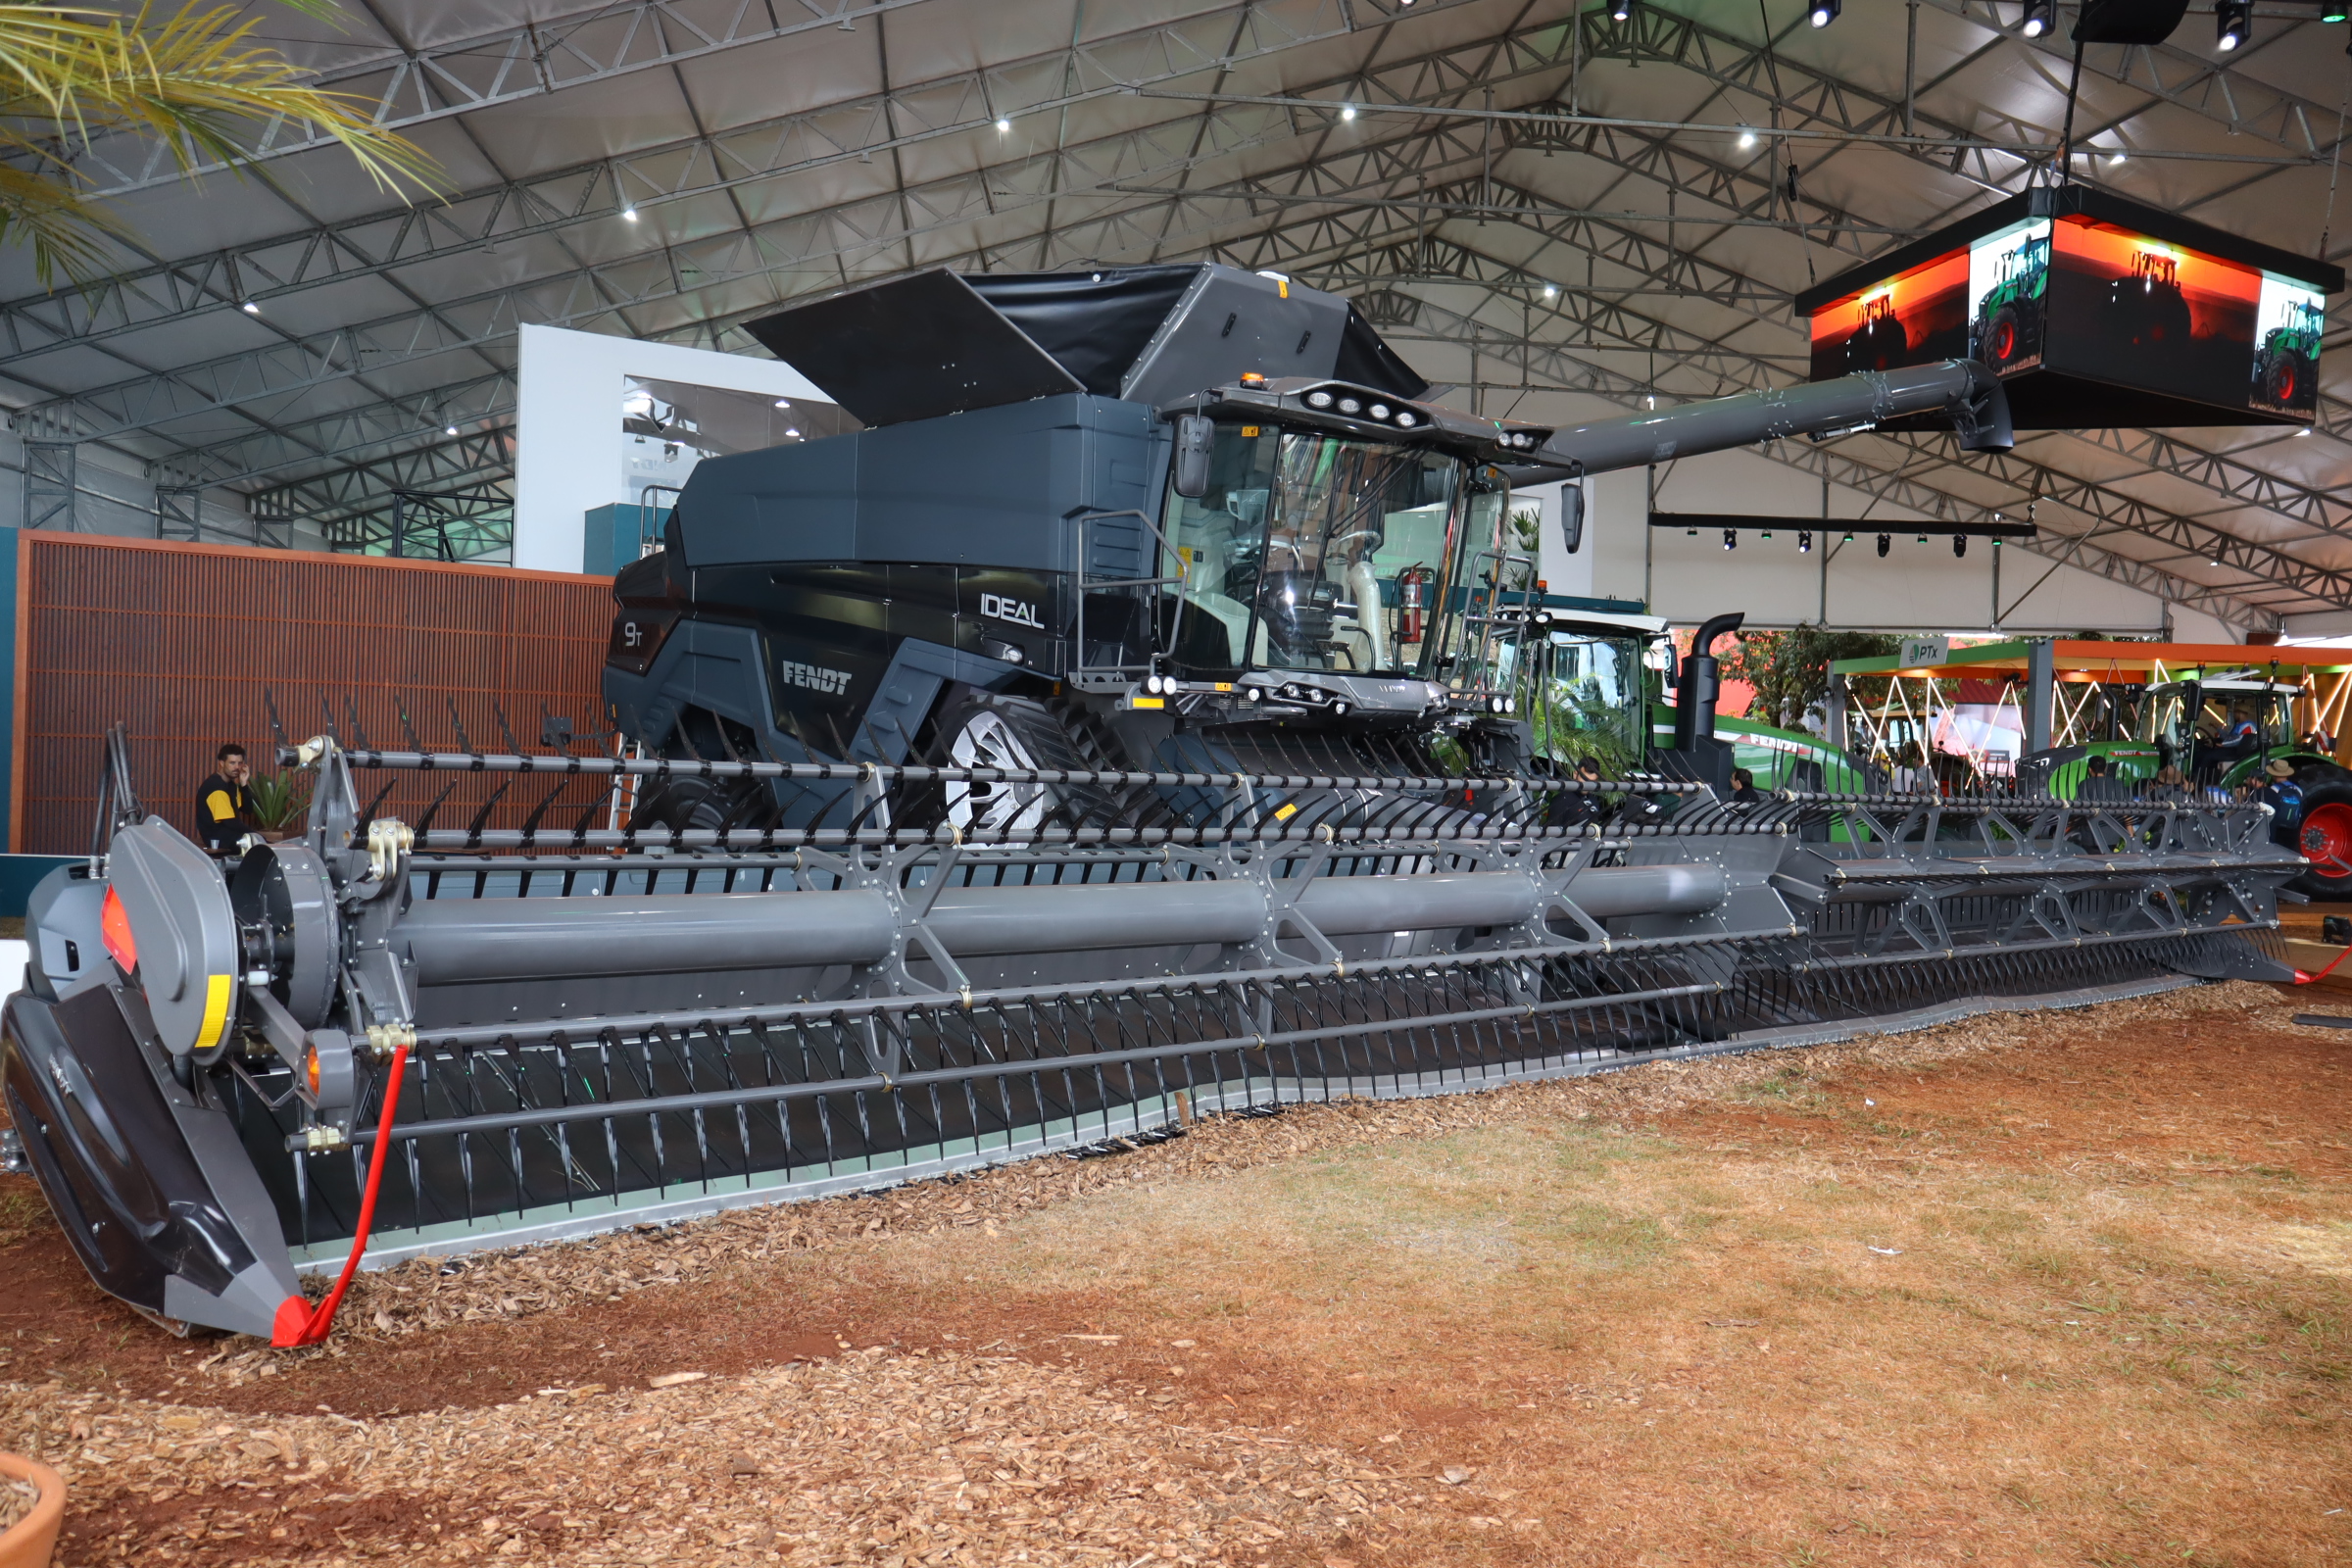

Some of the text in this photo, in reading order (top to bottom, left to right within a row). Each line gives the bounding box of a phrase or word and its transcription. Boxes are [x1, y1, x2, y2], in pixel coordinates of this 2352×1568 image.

[980, 593, 1046, 629] IDEAL
[782, 660, 853, 696] FENDT
[1749, 733, 1803, 753] FENDT
